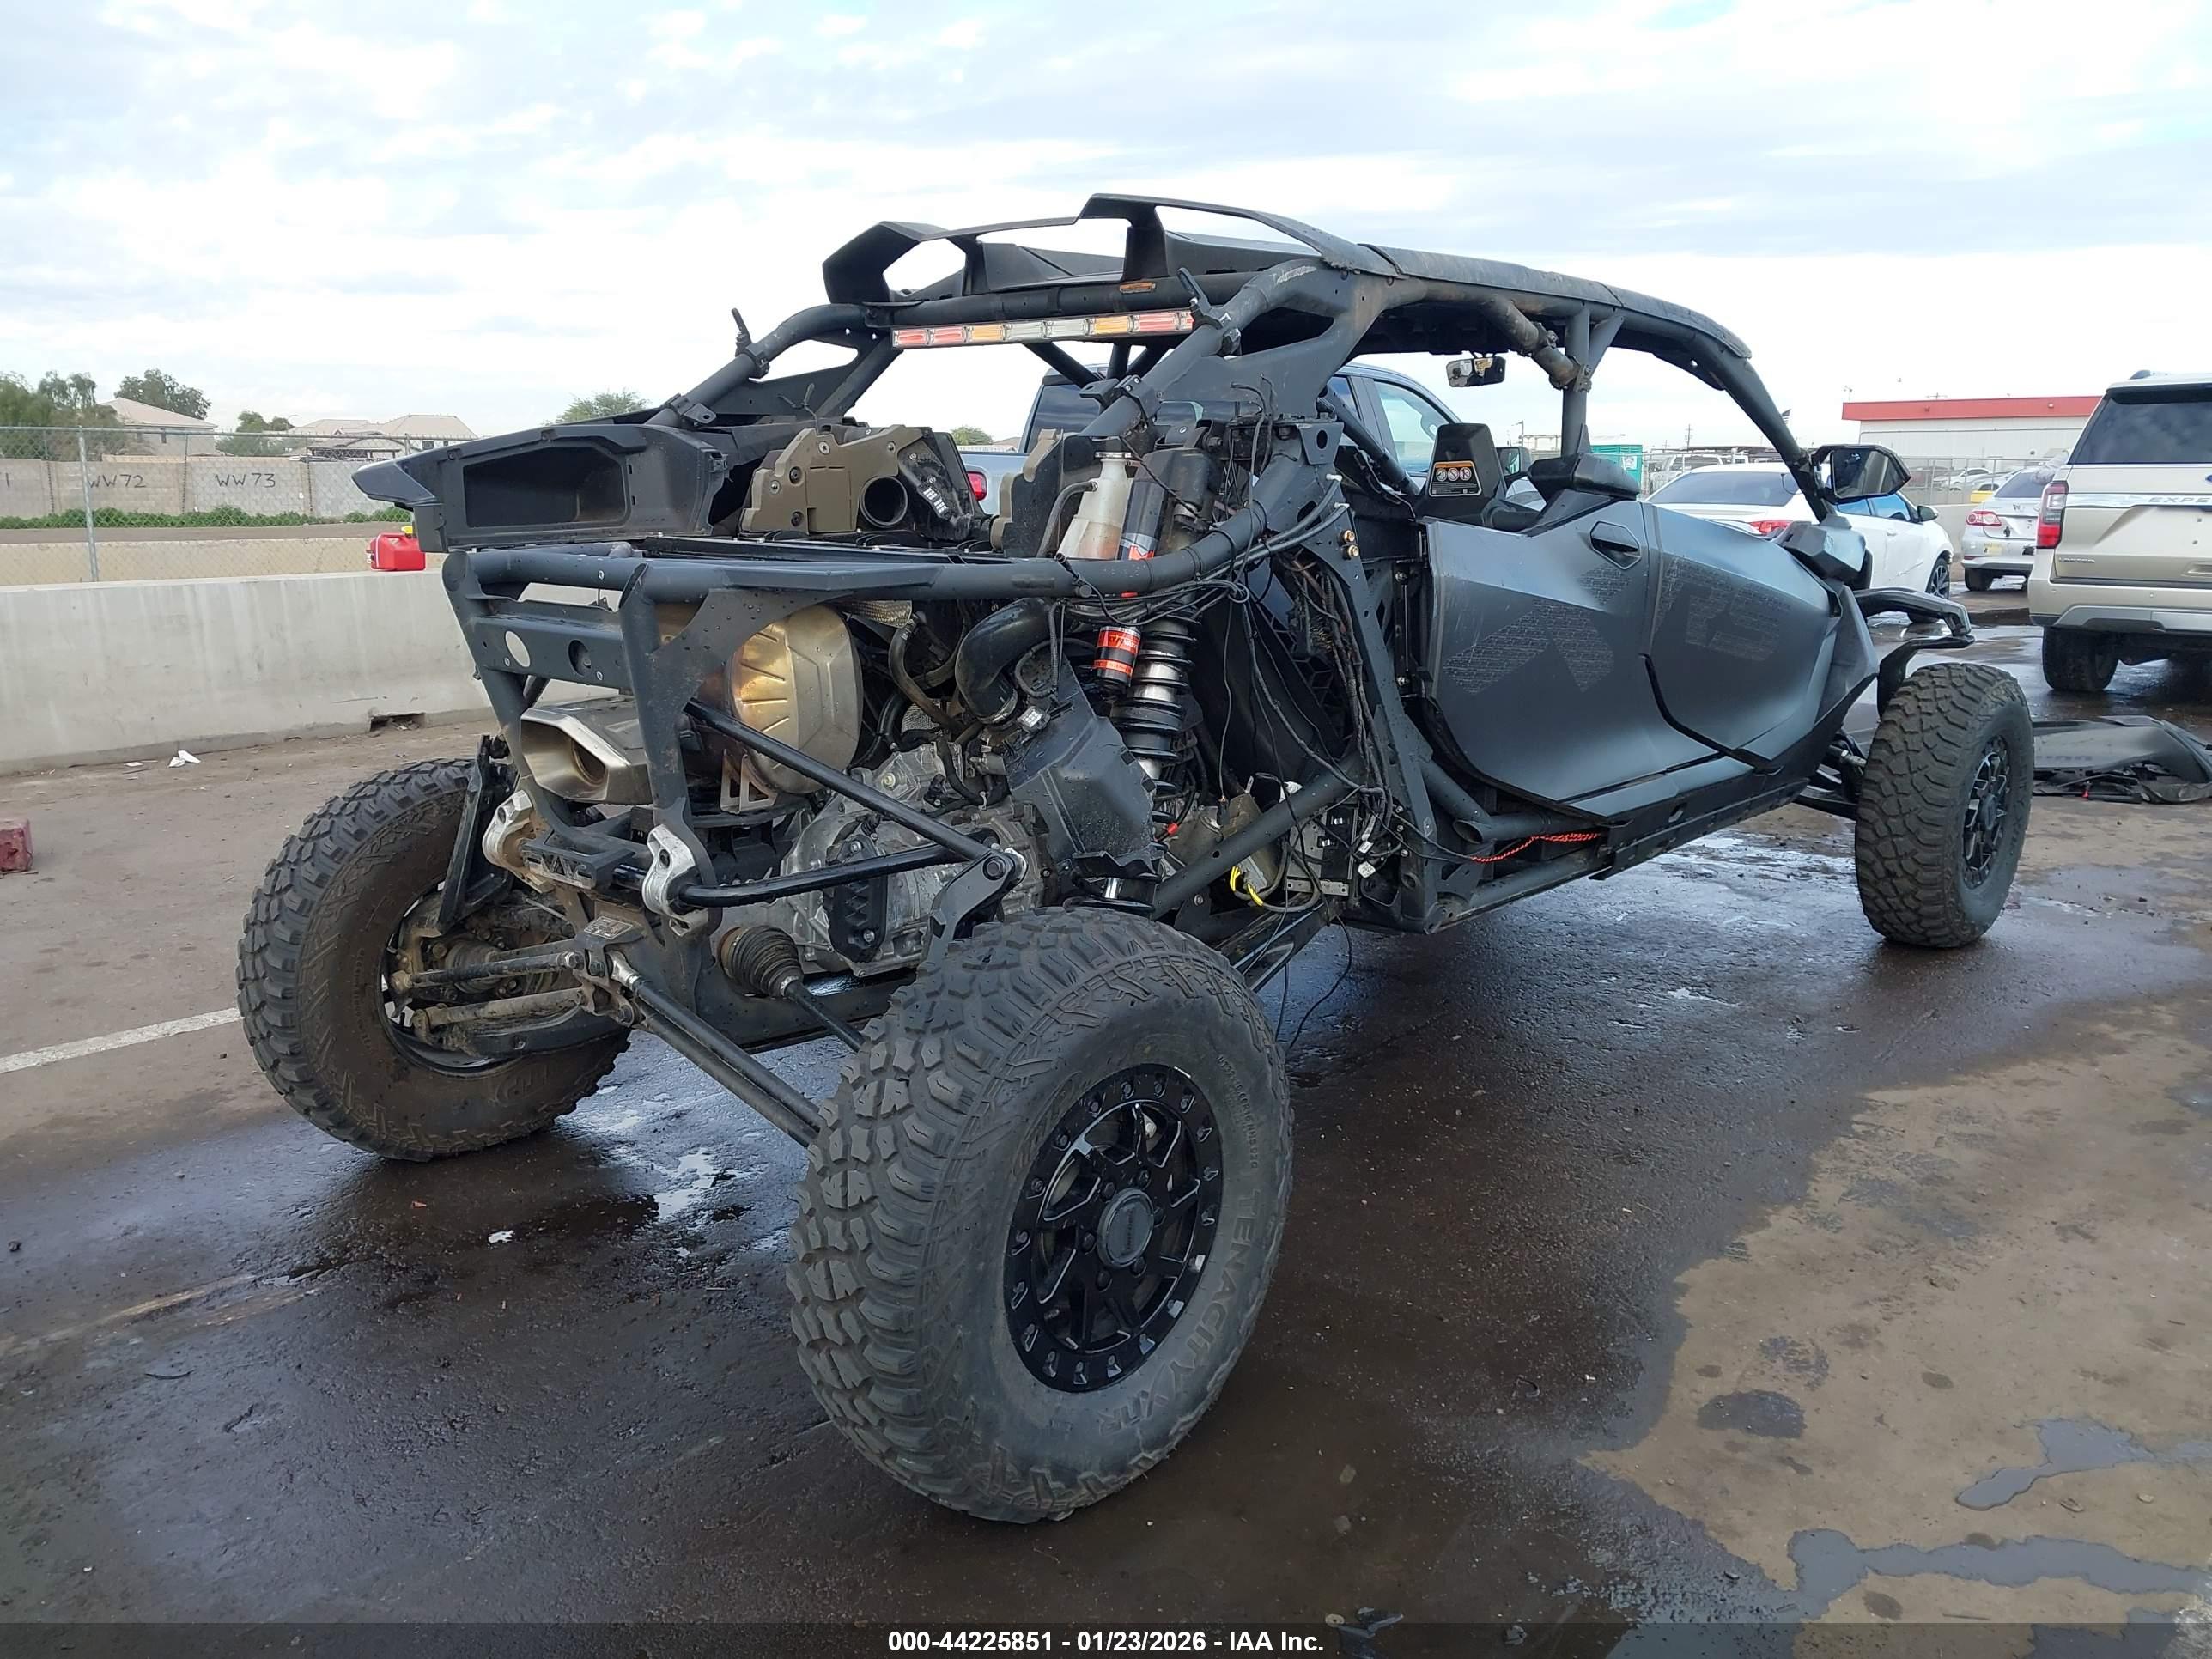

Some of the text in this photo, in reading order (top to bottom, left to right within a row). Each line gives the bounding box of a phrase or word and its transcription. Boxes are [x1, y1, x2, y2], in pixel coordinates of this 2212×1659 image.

[88, 473, 146, 488] WW 72
[215, 472, 276, 488] WW 73
[1169, 1187, 1261, 1393] TENACITY
